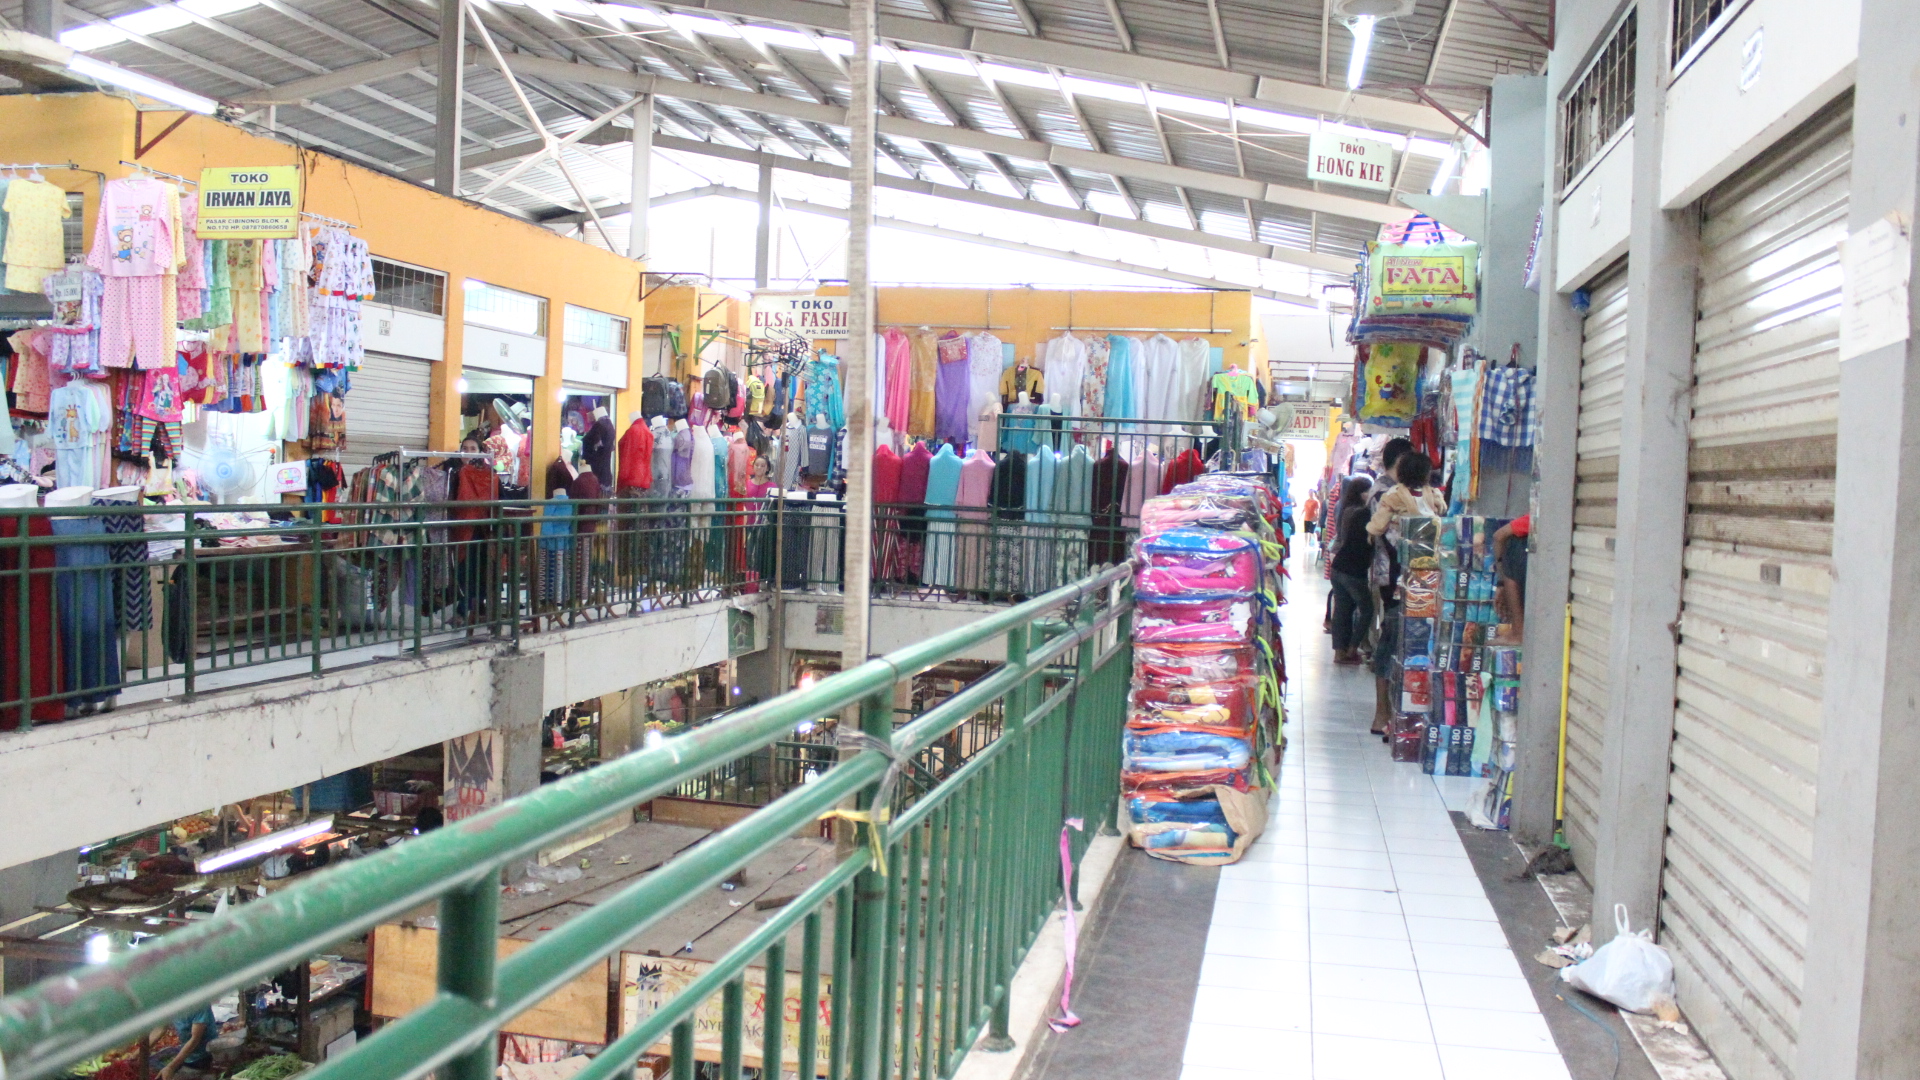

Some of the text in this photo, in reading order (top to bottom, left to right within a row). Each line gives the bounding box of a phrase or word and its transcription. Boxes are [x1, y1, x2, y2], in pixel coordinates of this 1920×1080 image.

[1339, 141, 1365, 156] TOKO
[1316, 155, 1385, 182] HONG KIE
[230, 173, 269, 183] TOKO
[206, 190, 291, 207] IRWAN JAYA
[1386, 267, 1460, 285] FATA
[789, 300, 834, 310] TOKO
[754, 311, 848, 328] ELSA FASHI
[1460, 572, 1468, 588] 180
[1428, 726, 1439, 744] 180
[1451, 728, 1461, 746] 180
[1463, 728, 1473, 746] 180
